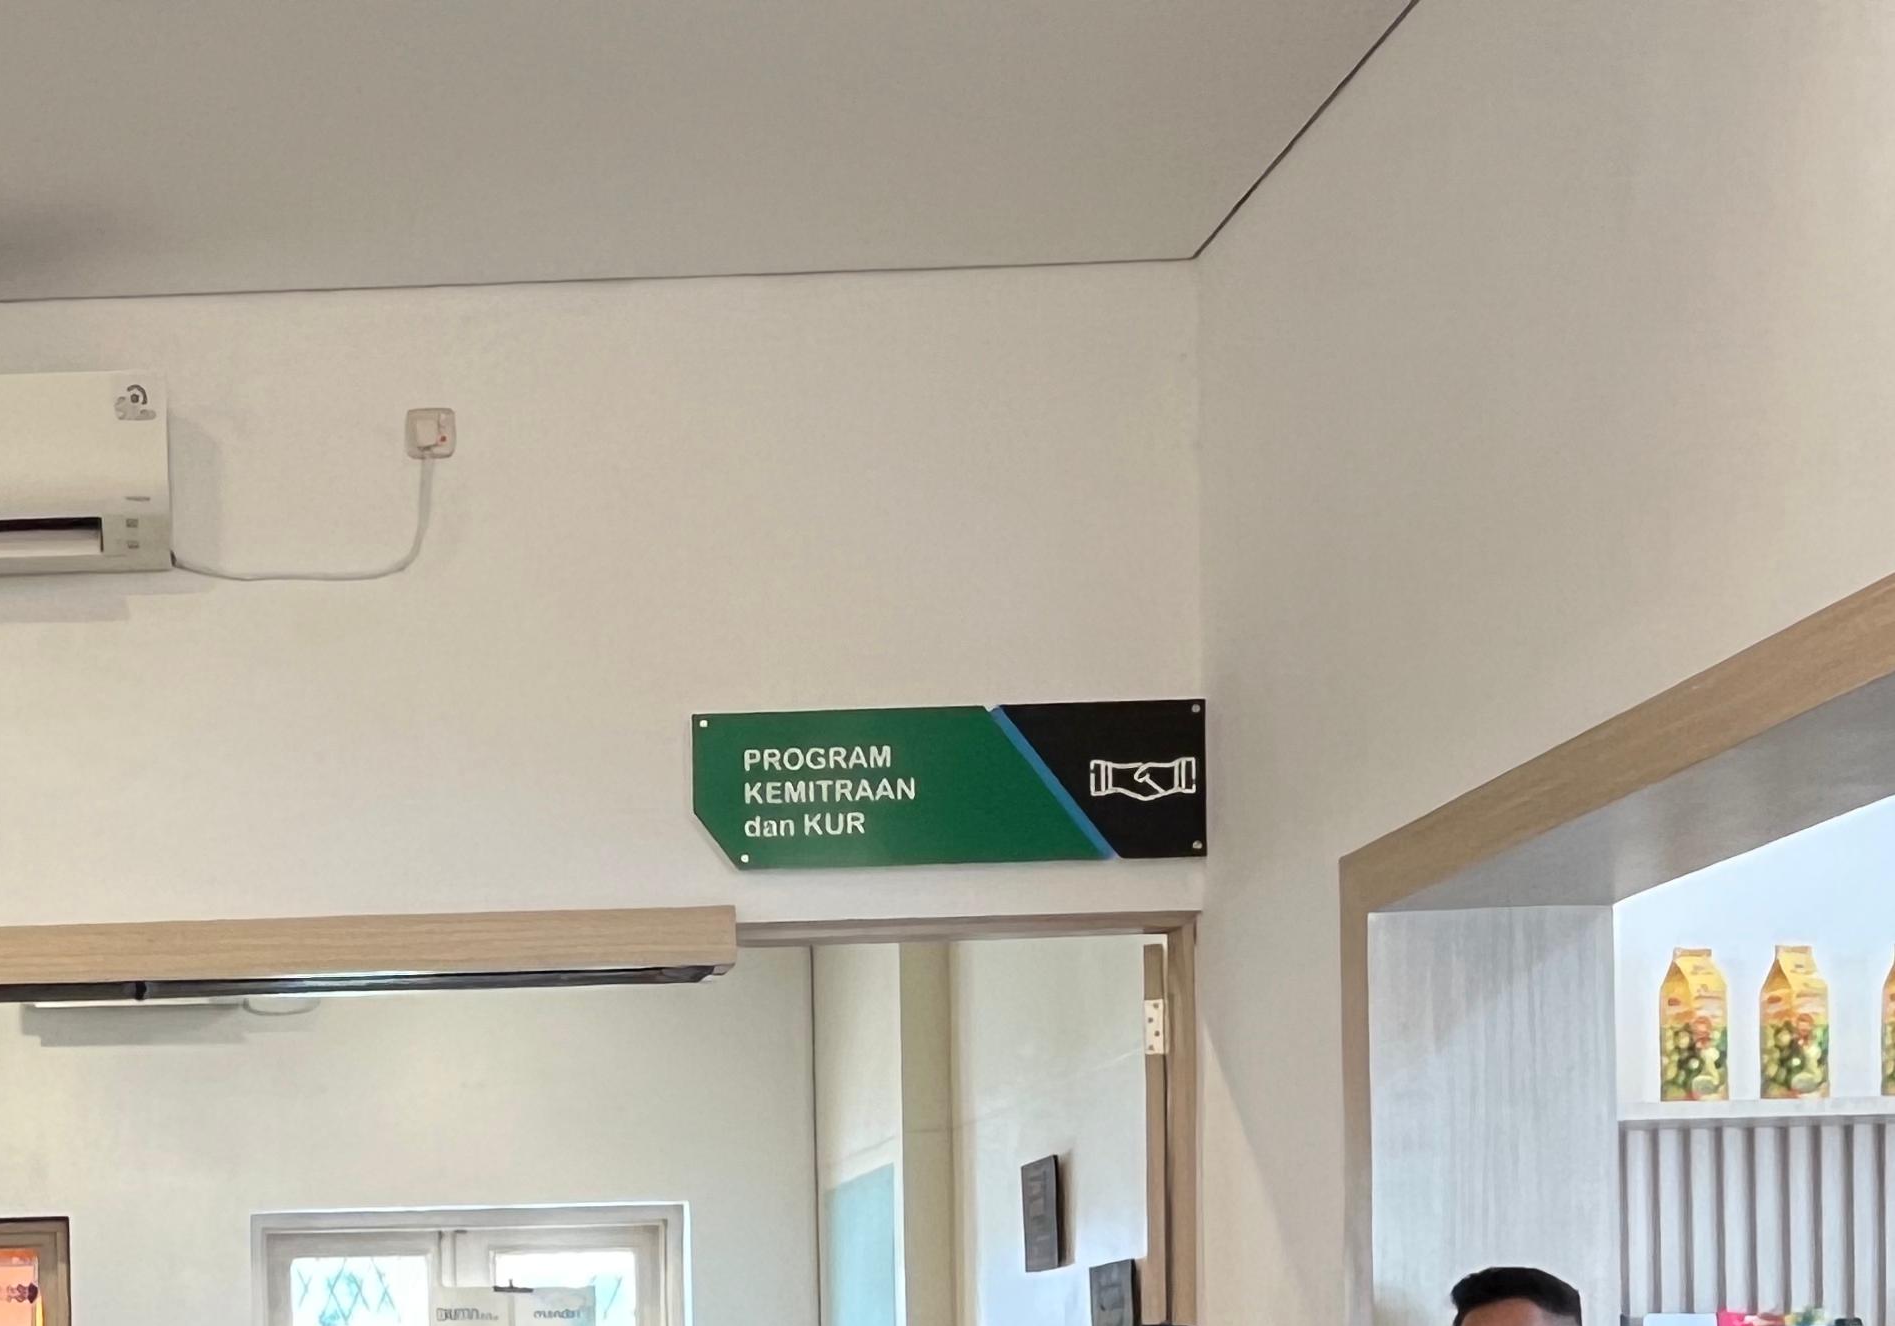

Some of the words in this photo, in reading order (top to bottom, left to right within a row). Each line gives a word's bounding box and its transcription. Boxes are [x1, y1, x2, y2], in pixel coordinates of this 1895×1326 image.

[743, 745, 891, 771] PROGRAM
[744, 777, 915, 804] KEMITRAAN
[744, 815, 795, 837] dan
[804, 812, 865, 835] KUR
